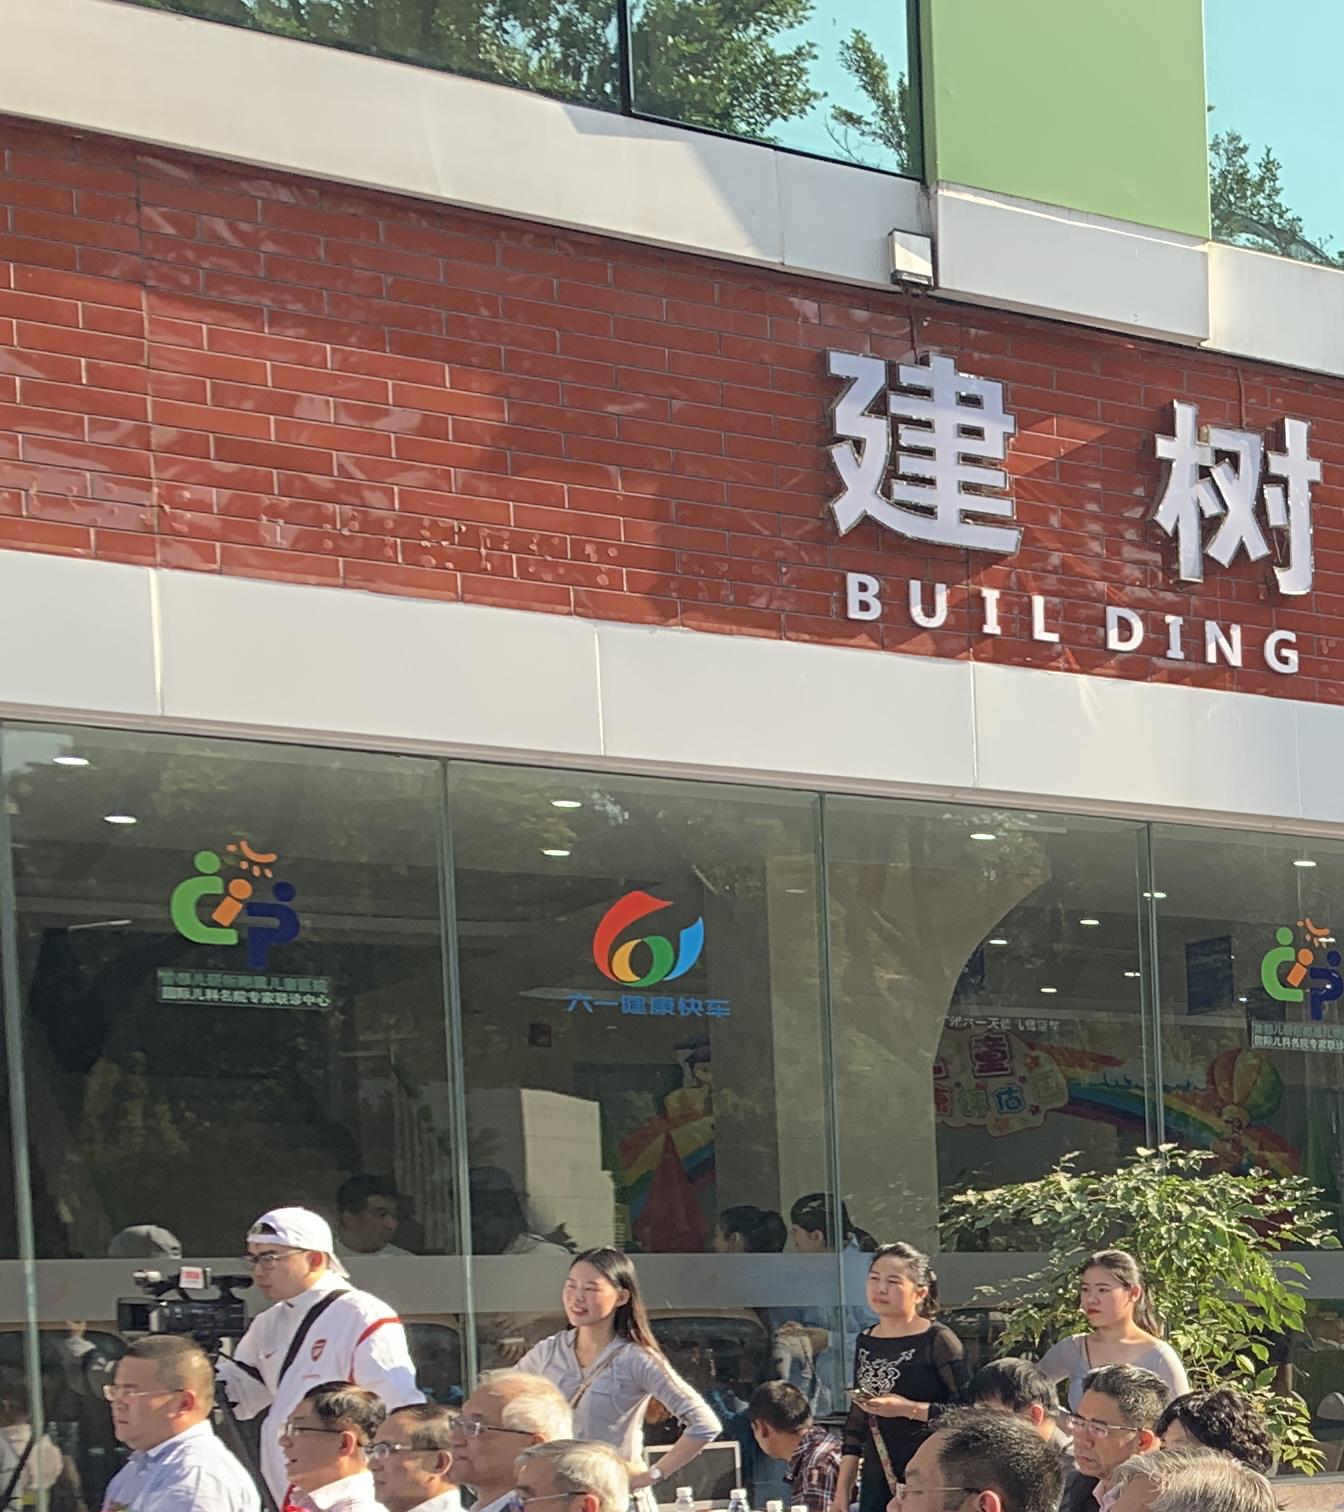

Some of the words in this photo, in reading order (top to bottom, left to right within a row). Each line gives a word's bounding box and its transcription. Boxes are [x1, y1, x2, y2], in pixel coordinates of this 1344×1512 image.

[565, 992, 732, 1018] 六一健康快车
